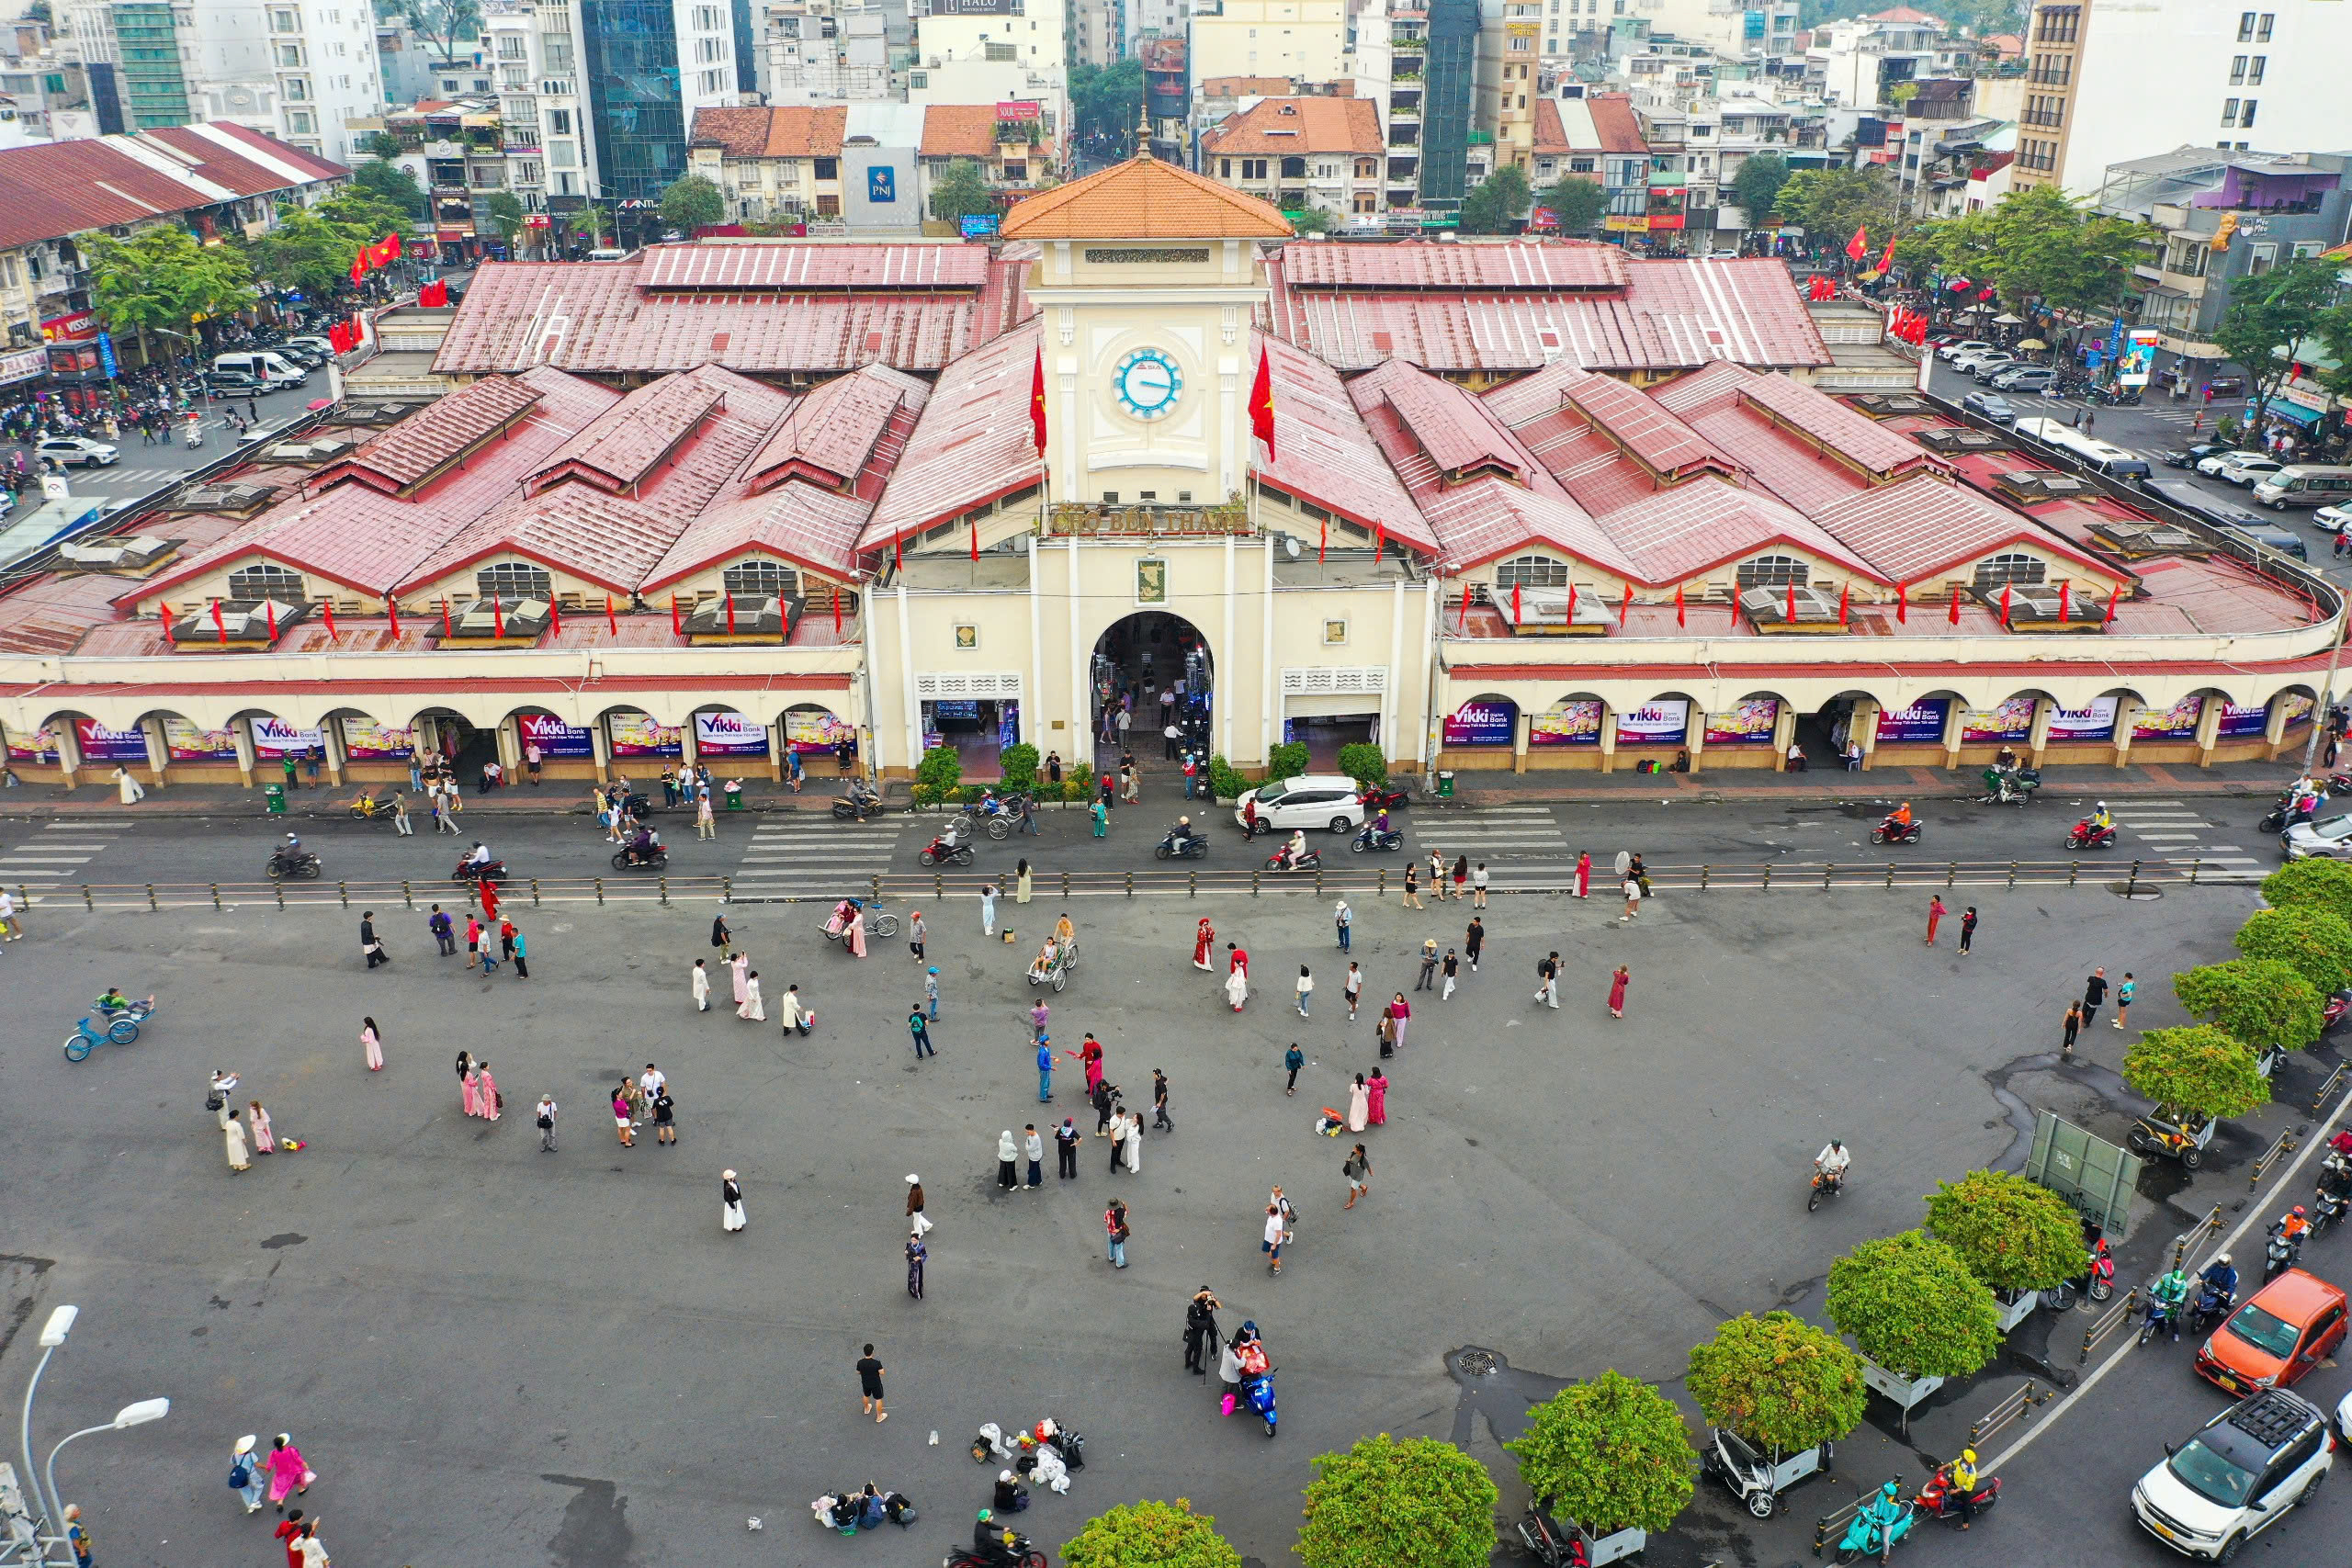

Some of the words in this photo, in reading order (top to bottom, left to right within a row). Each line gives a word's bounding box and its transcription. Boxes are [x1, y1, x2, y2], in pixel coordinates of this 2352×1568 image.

[999, 107, 1015, 118] SOUL
[873, 186, 890, 197] PNJ
[1052, 509, 1102, 533] CHỢ
[1109, 505, 1154, 532] BẾN
[1166, 506, 1249, 532] THÀNH
[701, 713, 741, 732] Vikki
[1453, 703, 1489, 723] Vikki
[256, 717, 297, 737] Vikki
[524, 715, 565, 735] Vikki
